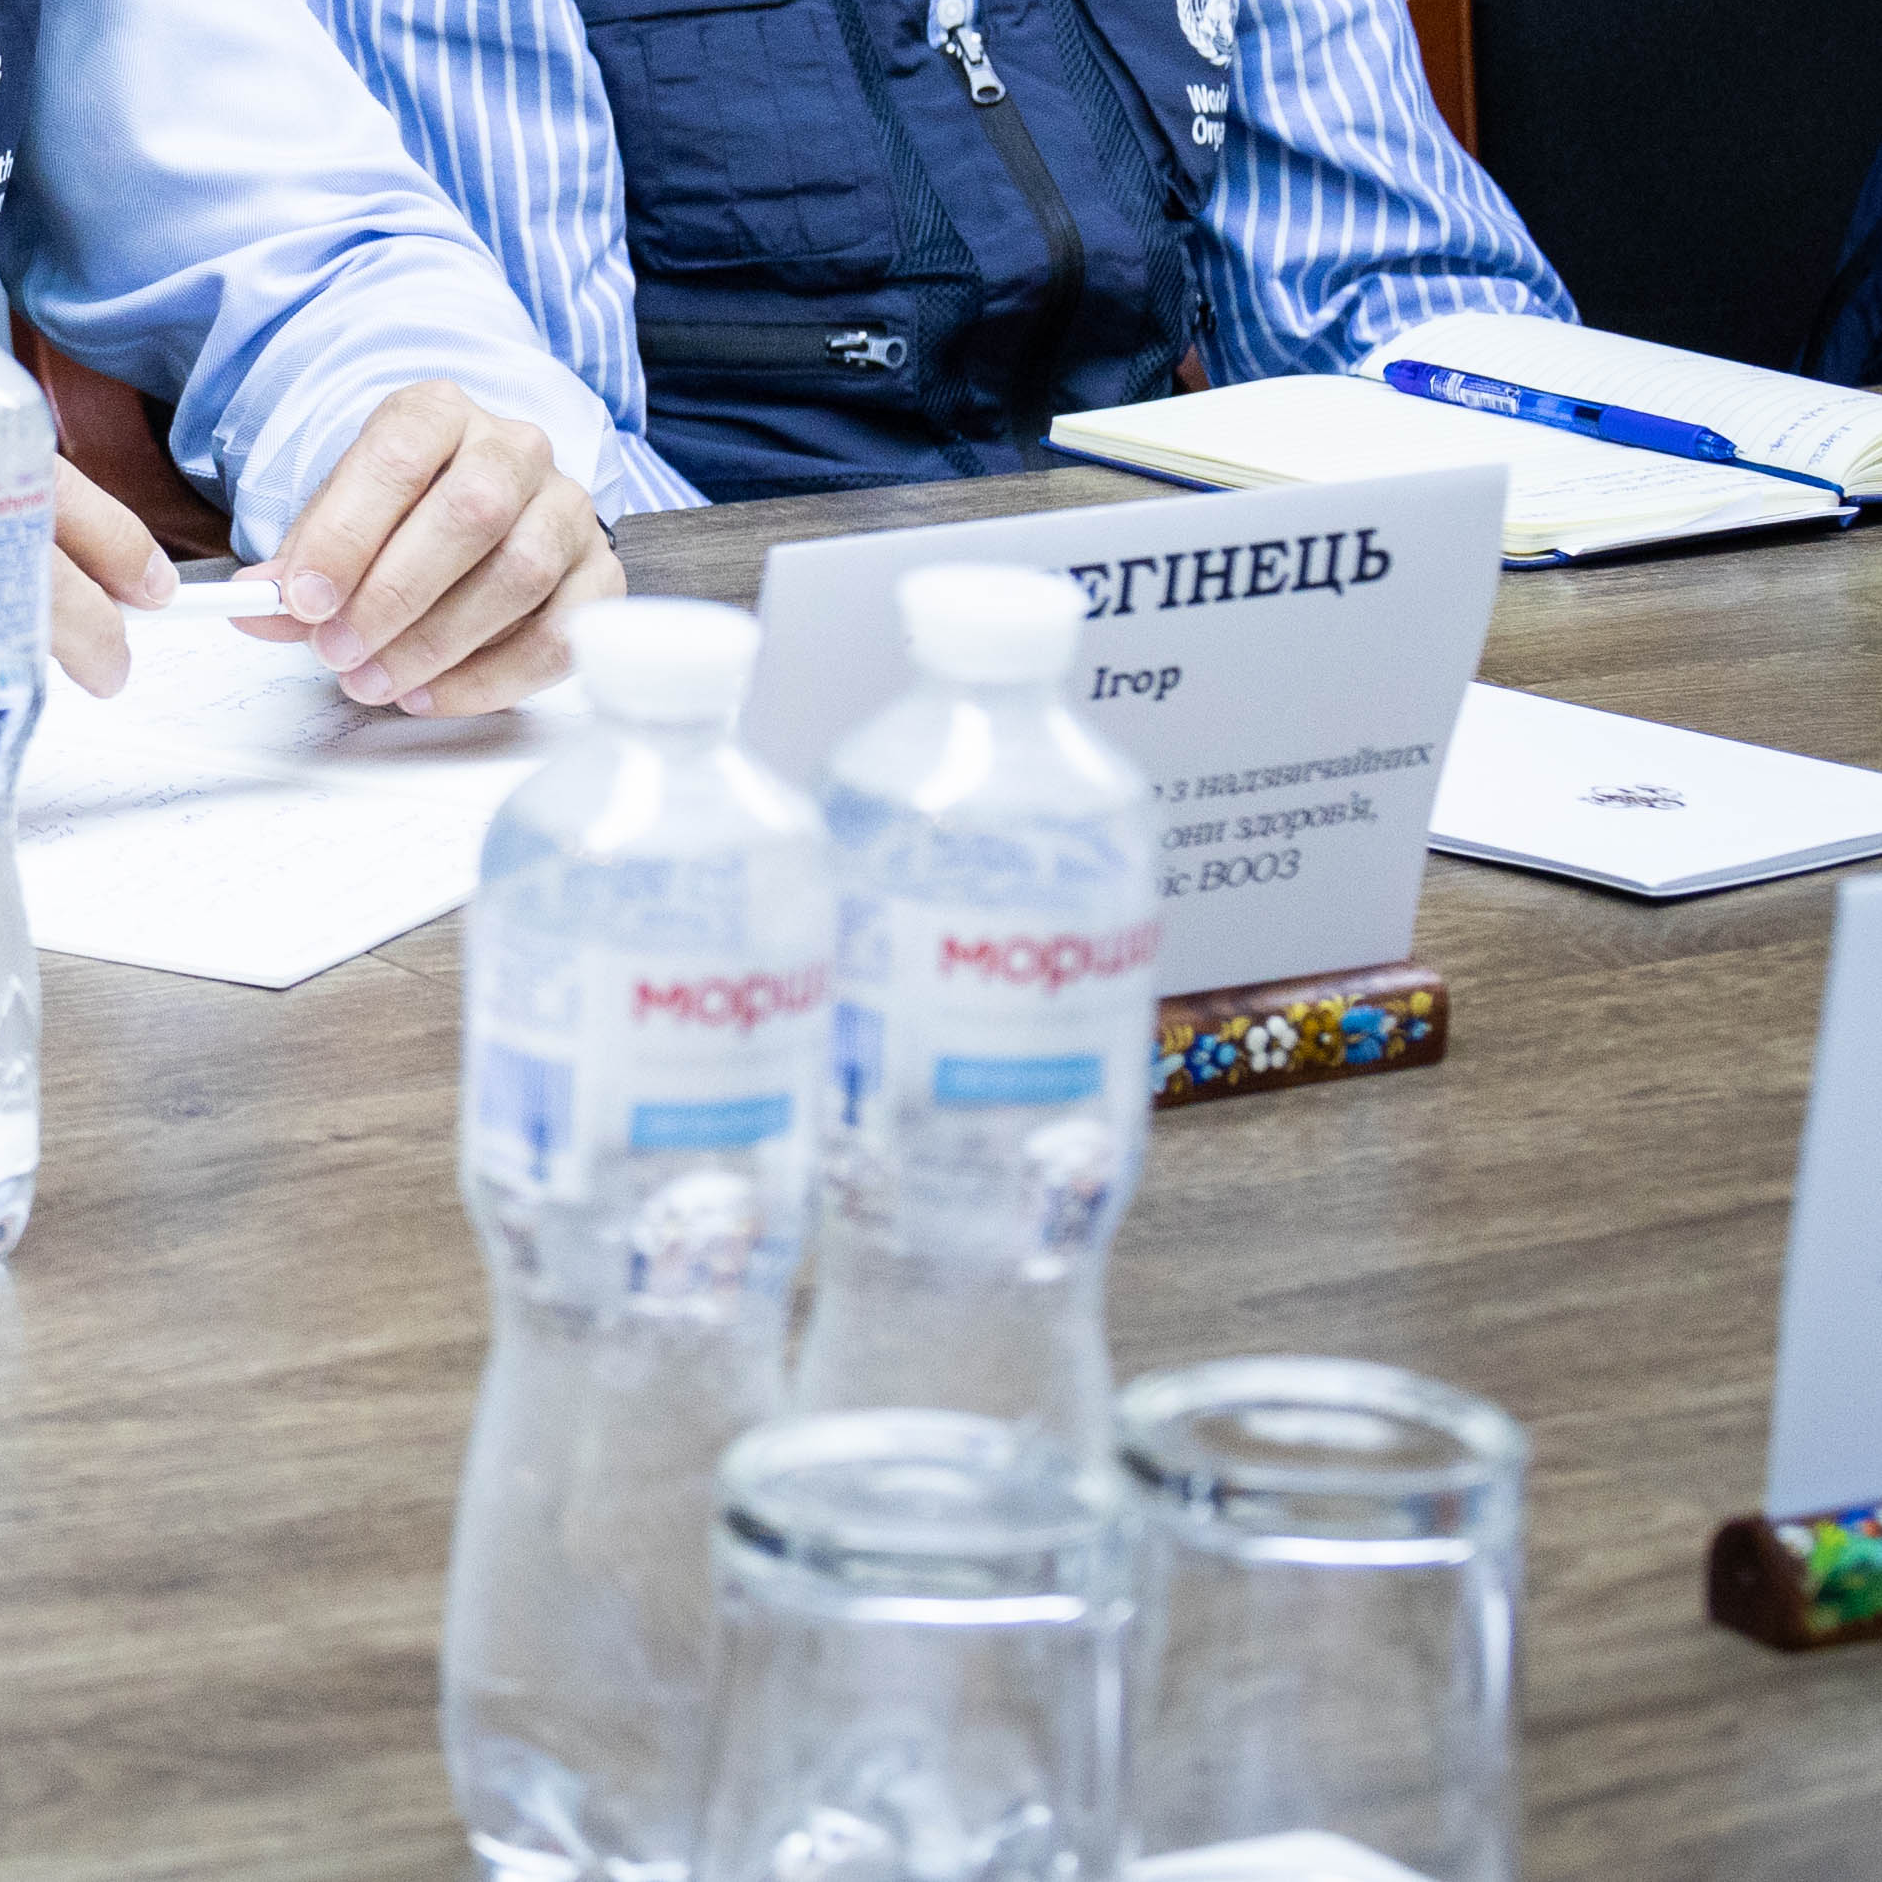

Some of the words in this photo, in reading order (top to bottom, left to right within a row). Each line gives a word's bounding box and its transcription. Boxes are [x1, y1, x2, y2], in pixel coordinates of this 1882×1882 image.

[1068, 526, 1392, 623] ЕГІНЕЦЬ
[1089, 666, 1182, 702] Ігор
[1198, 847, 1302, 893] ВООЗ
